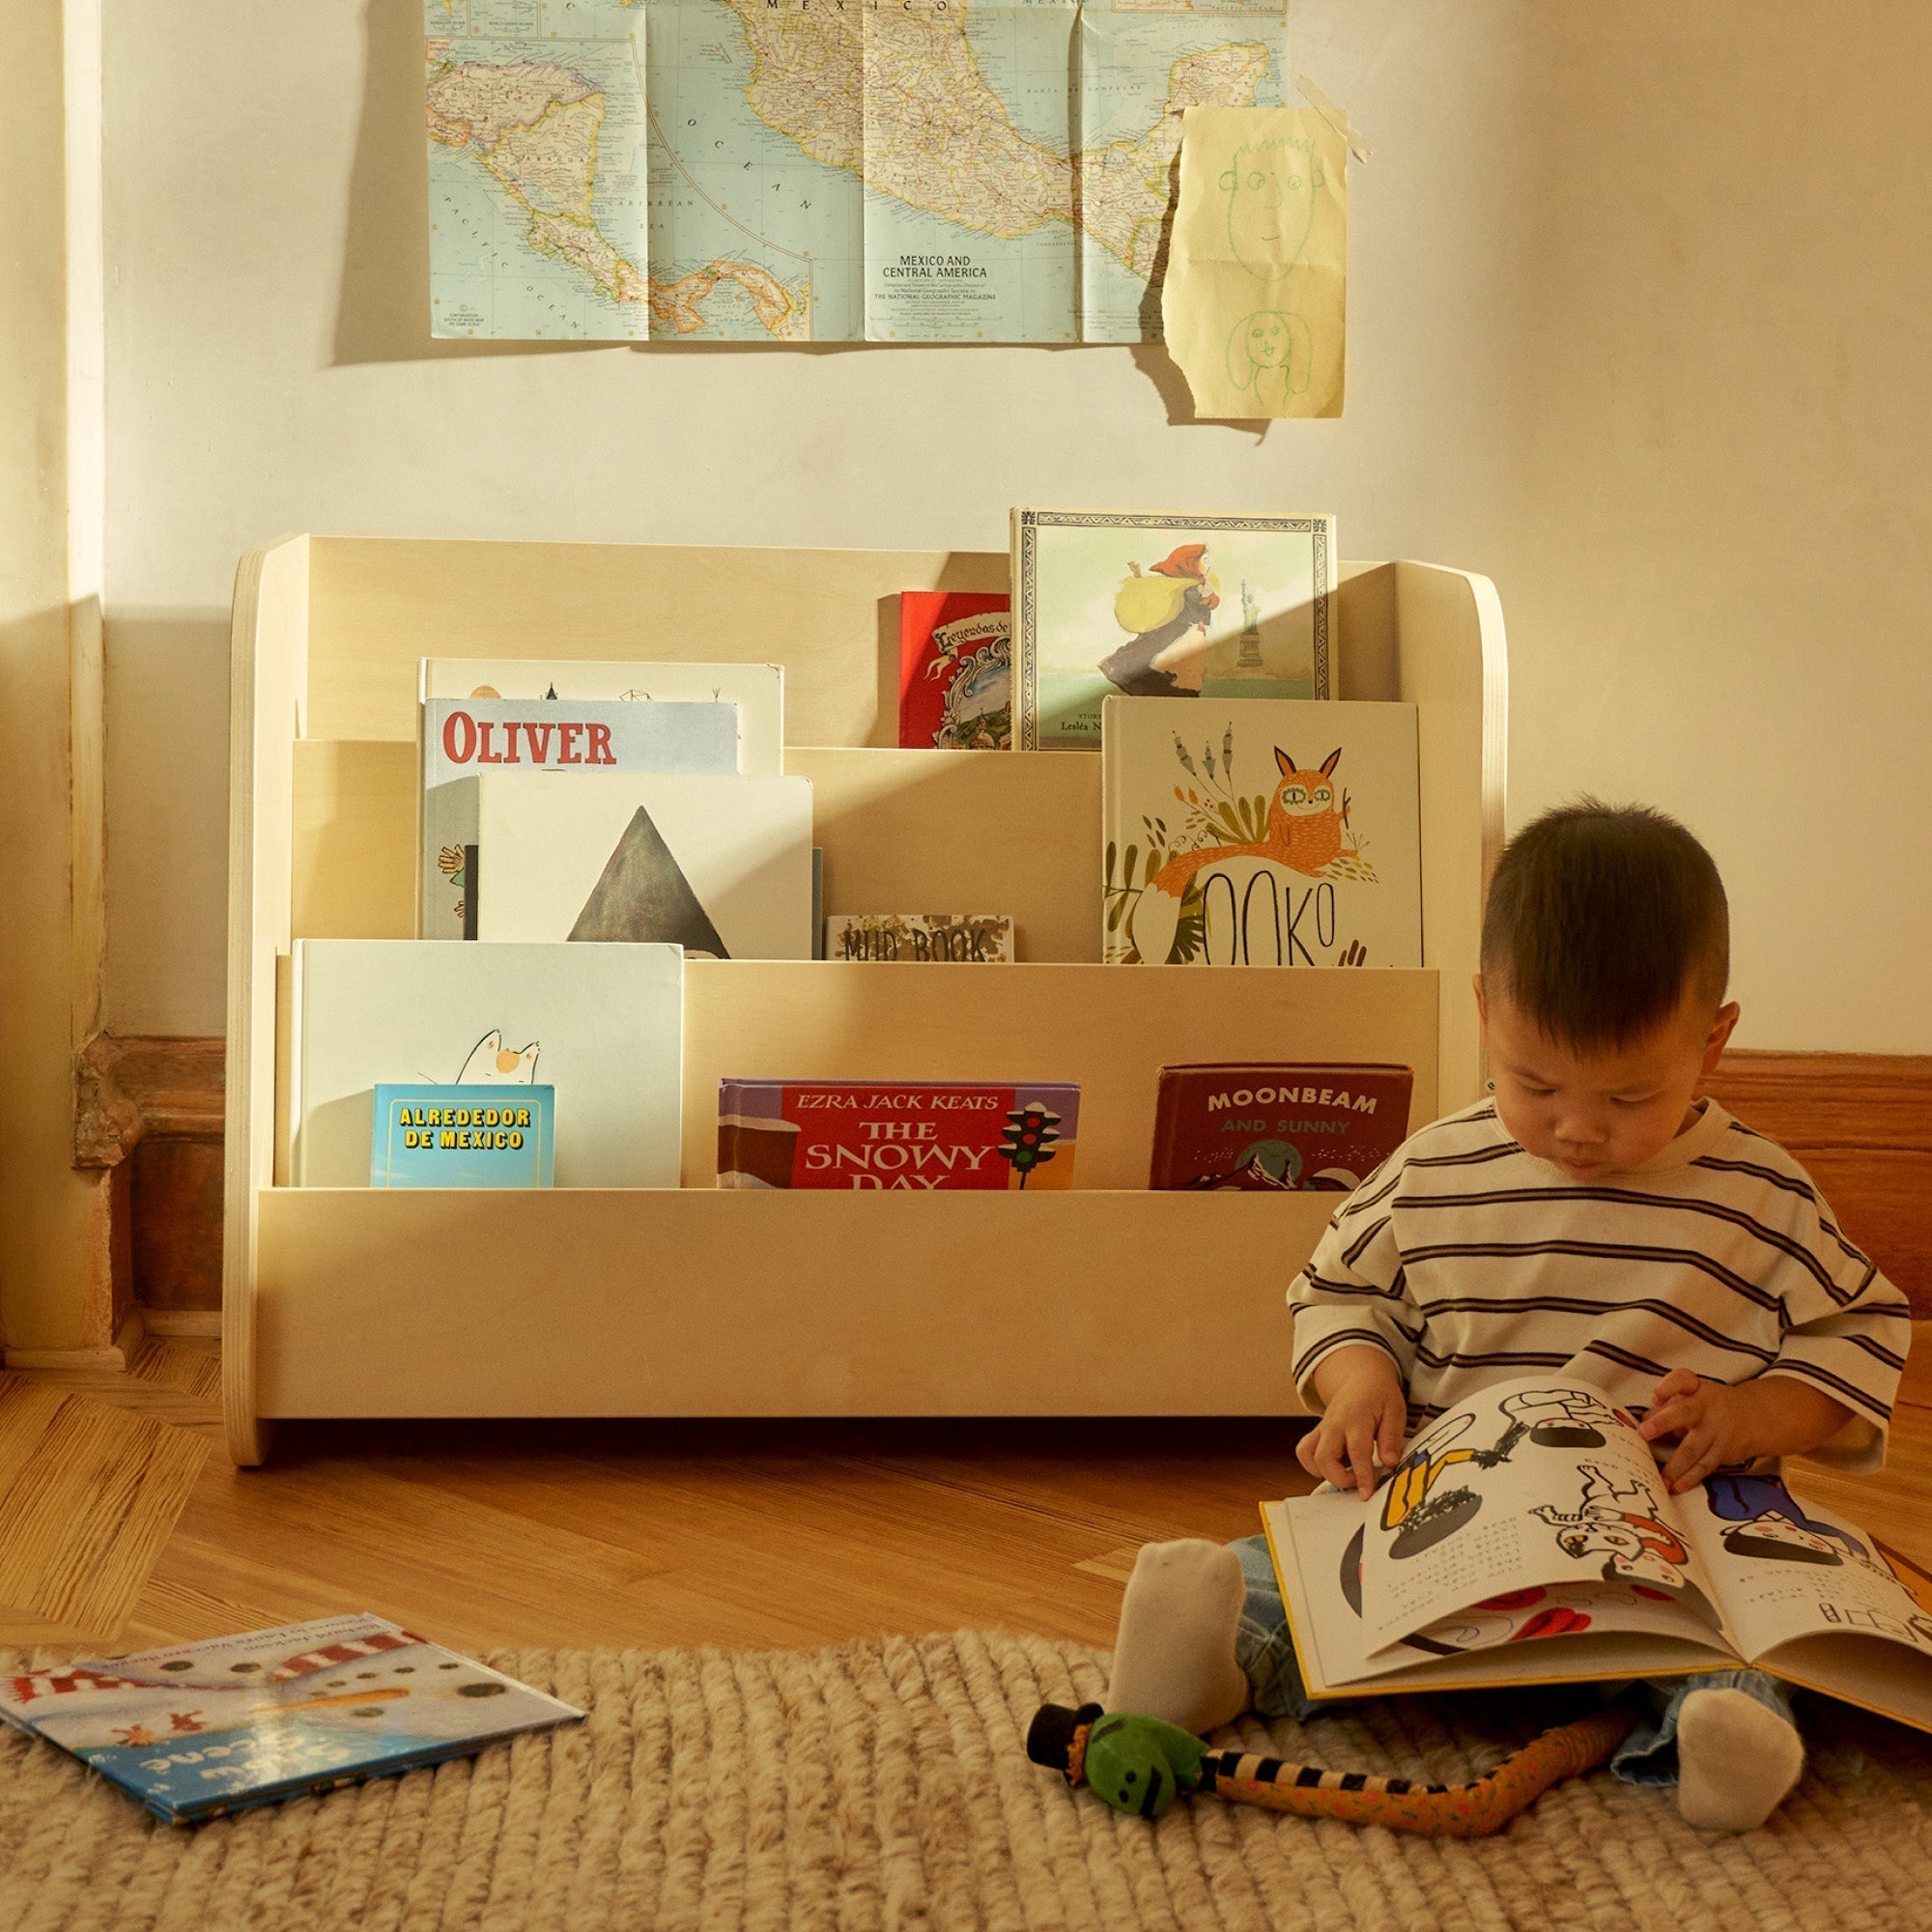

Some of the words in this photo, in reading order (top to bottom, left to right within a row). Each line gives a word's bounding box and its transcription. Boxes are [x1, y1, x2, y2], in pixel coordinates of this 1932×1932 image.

[766, 0, 948, 11] MEXICO
[899, 255, 945, 266] MEXICO
[947, 255, 971, 266] AND
[882, 267, 933, 277] CENTRAL
[935, 267, 987, 278] AMERICA
[934, 622, 995, 648] Leyendas
[442, 710, 617, 765] OLIVER
[844, 929, 898, 961] MUD
[911, 928, 987, 962] BOOK
[795, 1094, 858, 1109] EZRA
[863, 1094, 923, 1109] JACK
[929, 1094, 1000, 1110] KEATS
[1208, 1087, 1378, 1115] MOONBEAM
[398, 1107, 531, 1128] ALREDEDOR
[1220, 1119, 1267, 1132] AND
[1275, 1119, 1351, 1134] SUNNY
[404, 1129, 434, 1150] DE
[440, 1129, 526, 1151] MEXICO
[858, 1121, 939, 1141] THE
[804, 1143, 995, 1171] SNOWY
[848, 1173, 952, 1190] DAY
